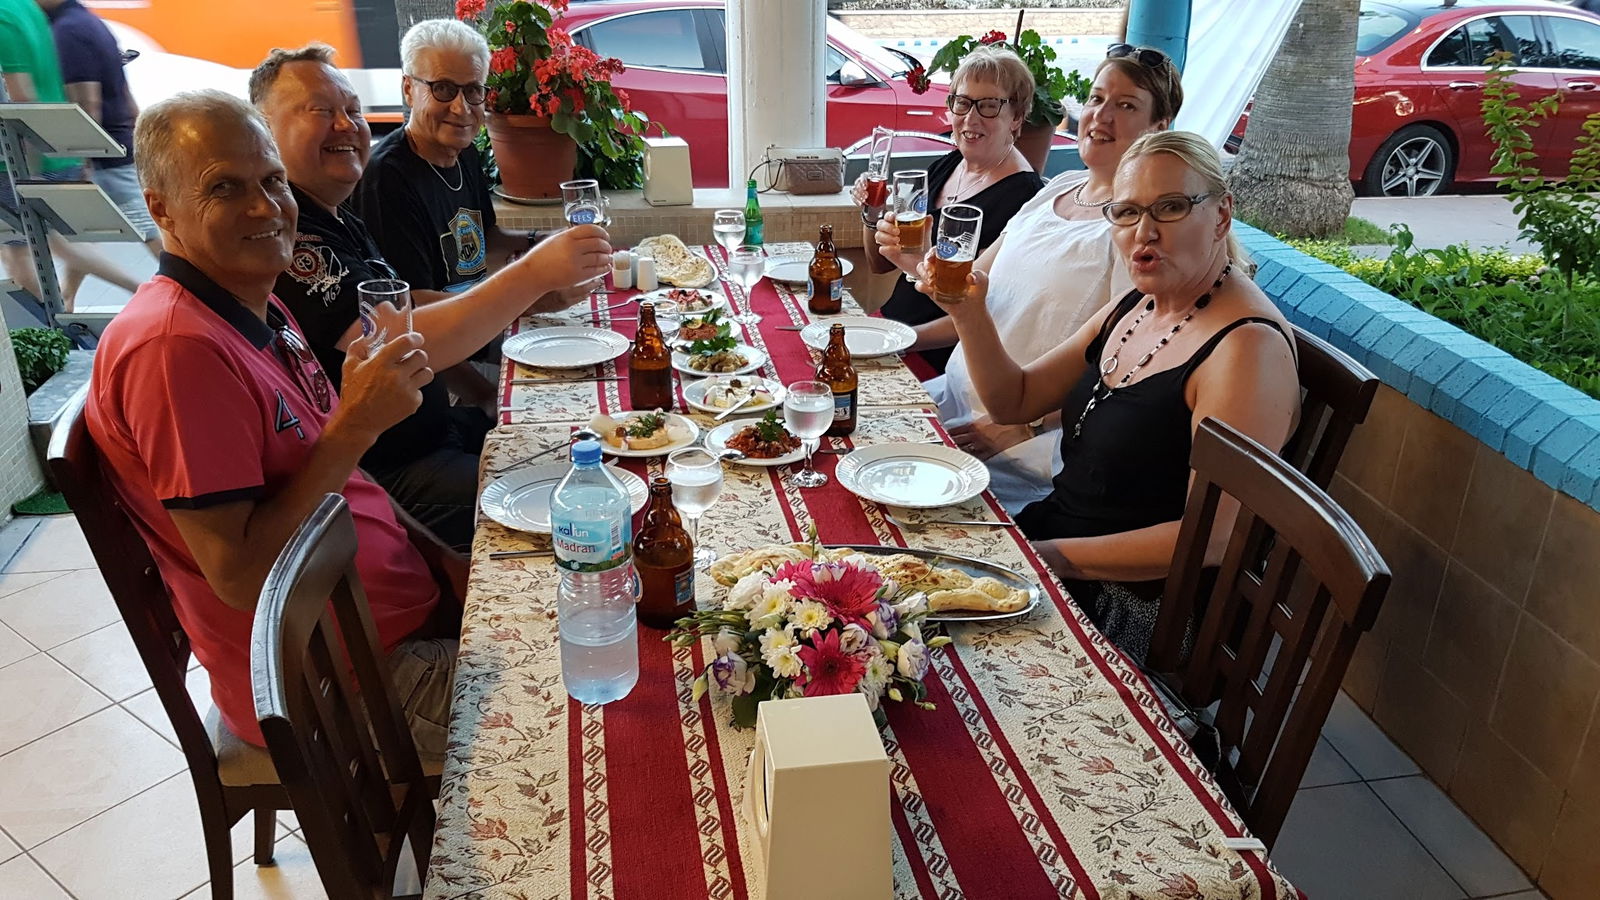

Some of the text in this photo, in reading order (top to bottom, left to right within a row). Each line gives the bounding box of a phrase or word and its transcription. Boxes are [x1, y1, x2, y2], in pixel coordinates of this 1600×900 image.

[572, 213, 592, 223] EFES
[275, 389, 305, 440] 4
[556, 538, 596, 553] Madran
